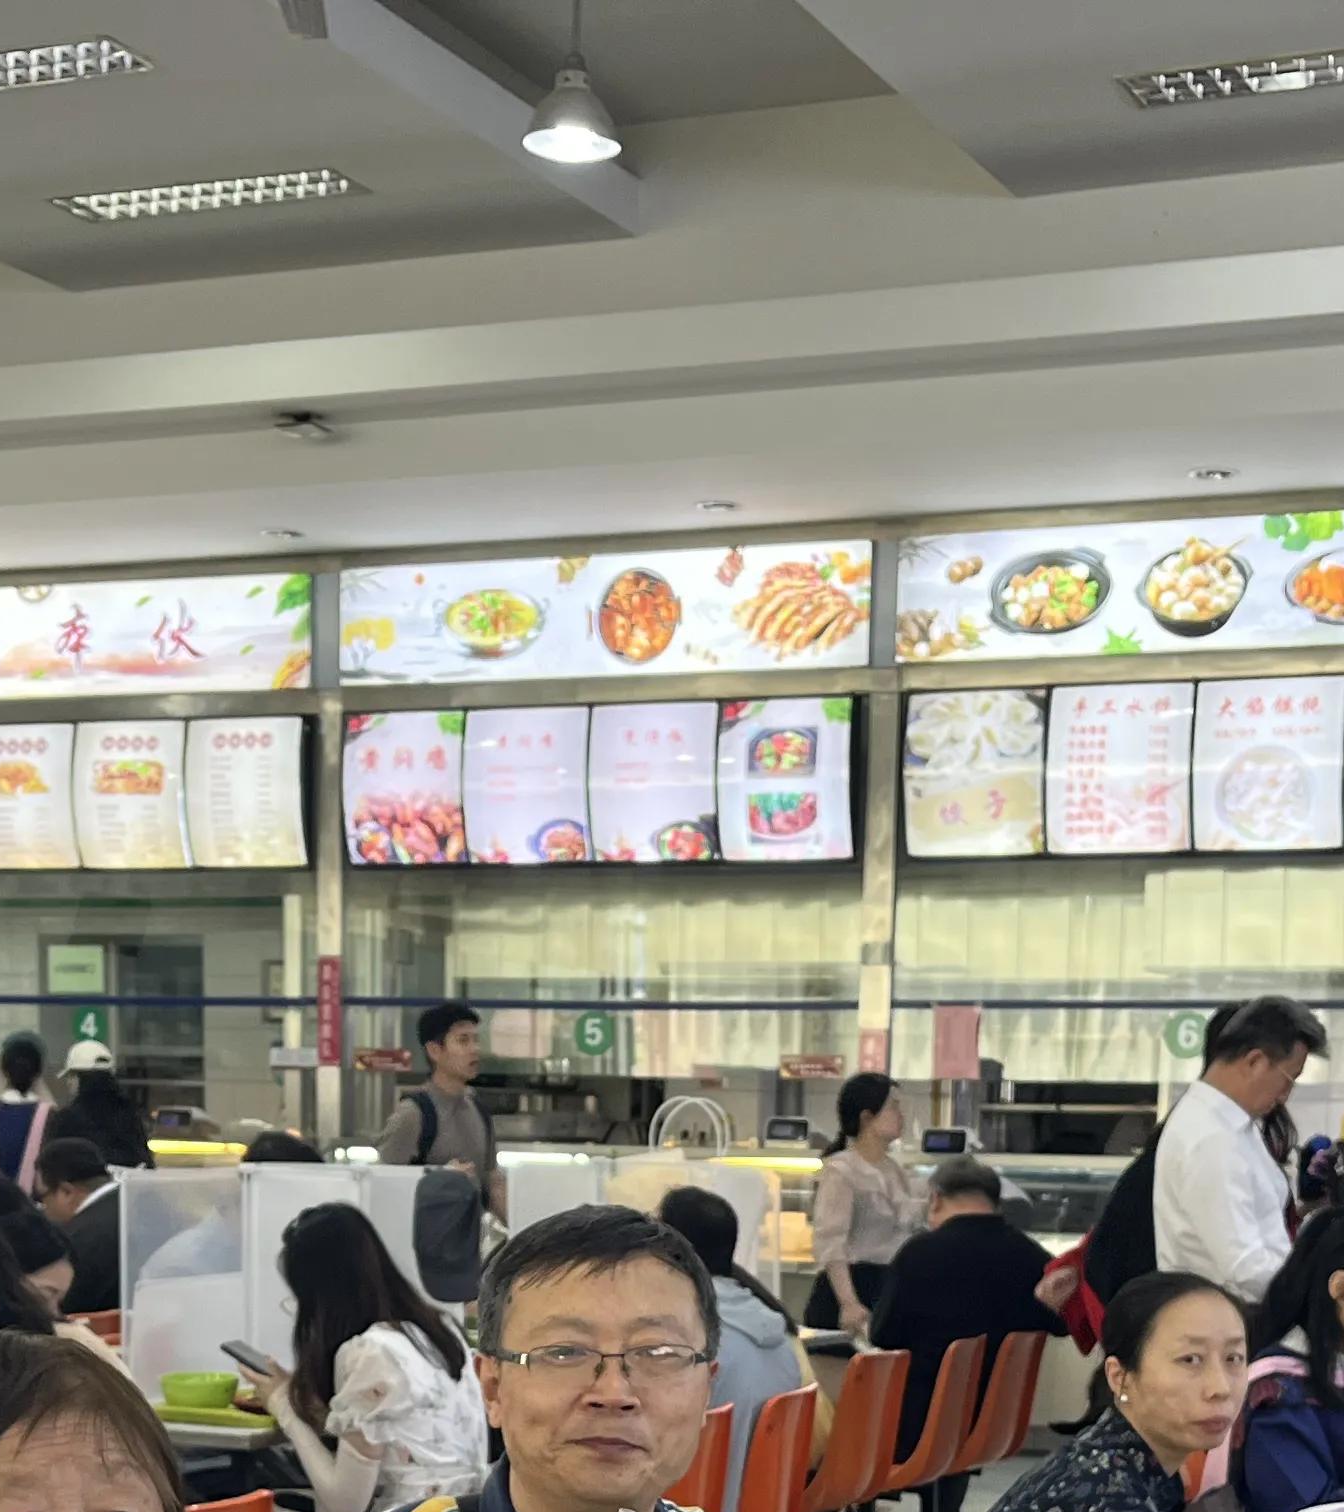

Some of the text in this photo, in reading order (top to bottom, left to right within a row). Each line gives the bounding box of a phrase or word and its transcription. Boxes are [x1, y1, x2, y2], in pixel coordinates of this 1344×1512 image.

[80, 1011, 98, 1038] 4
[585, 1018, 603, 1046] 5
[1178, 1019, 1199, 1049] 6
